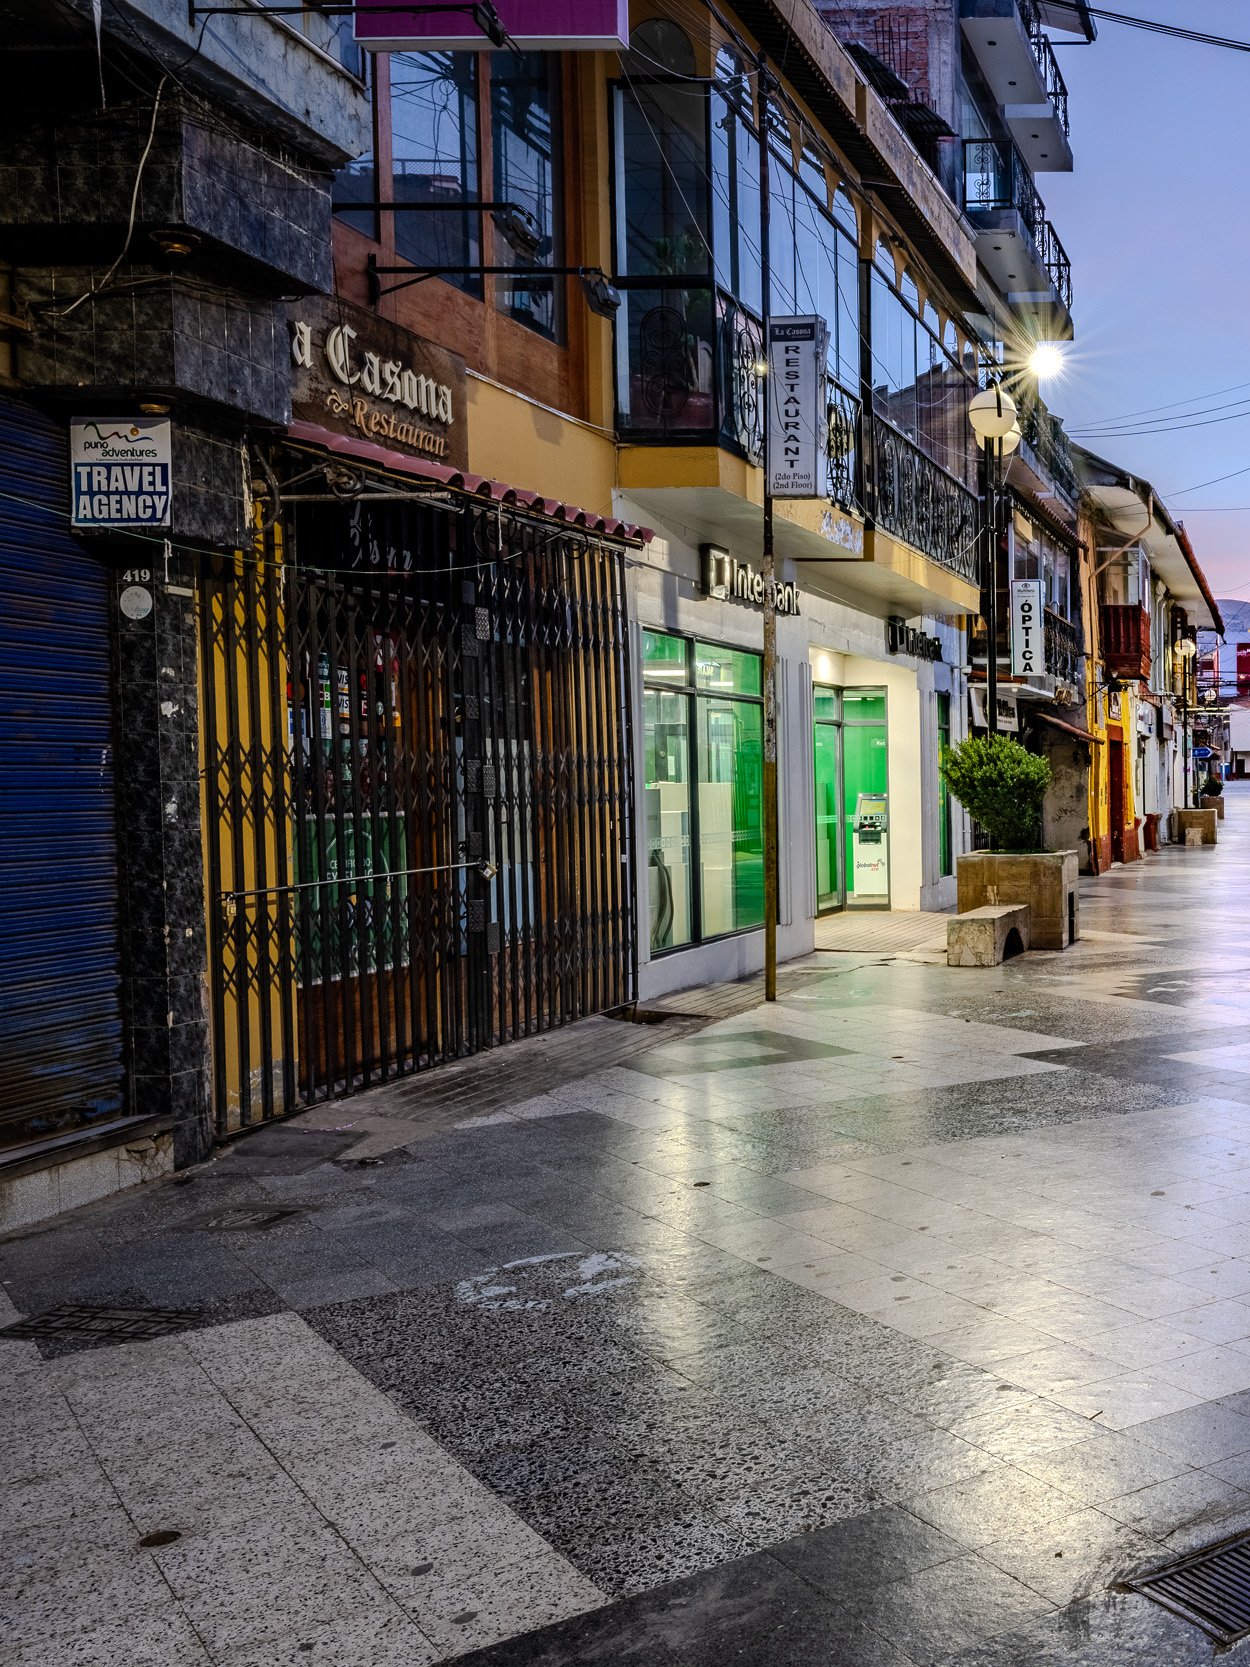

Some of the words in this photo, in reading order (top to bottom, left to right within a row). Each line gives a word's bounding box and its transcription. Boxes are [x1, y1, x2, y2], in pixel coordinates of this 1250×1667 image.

[786, 327, 811, 336] Casona
[326, 323, 455, 425] Casona
[783, 345, 802, 469] RESTAURANT
[83, 440, 109, 451] puno
[101, 446, 158, 458] adventures
[76, 465, 167, 492] TRAVEL
[774, 472, 791, 481] (2do
[792, 472, 811, 480] Piso)
[772, 482, 789, 490] (2nd
[791, 481, 813, 489] Floor)
[77, 494, 168, 519] AGENCY
[122, 569, 151, 582] 419
[1020, 600, 1034, 673] ÓPTICA
